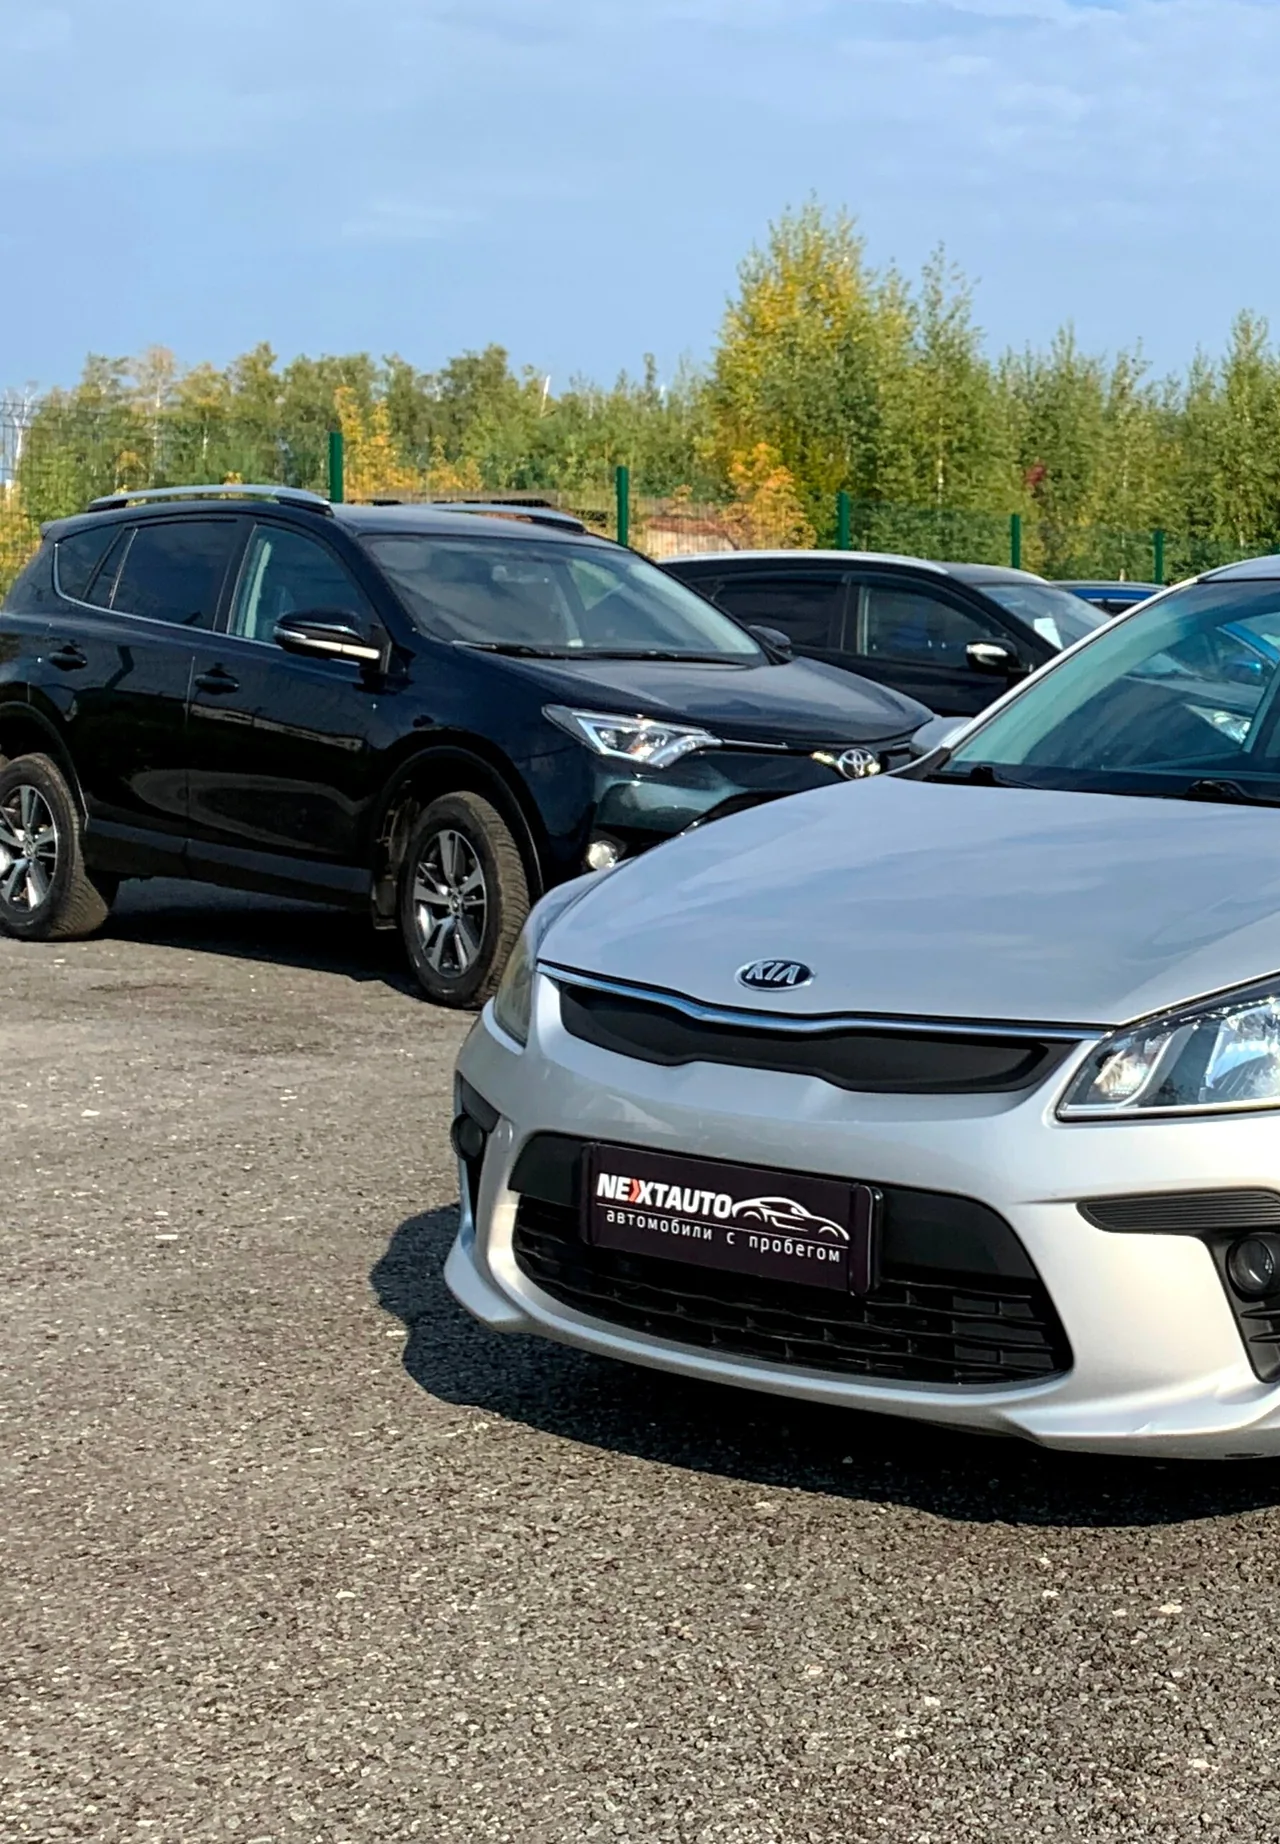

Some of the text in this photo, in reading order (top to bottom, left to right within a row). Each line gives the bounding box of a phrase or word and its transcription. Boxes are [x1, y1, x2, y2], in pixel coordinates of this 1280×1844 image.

[746, 961, 801, 984] KIA
[597, 1173, 733, 1219] NEXTAUTO
[606, 1210, 841, 1262] автомобили с пробегом
